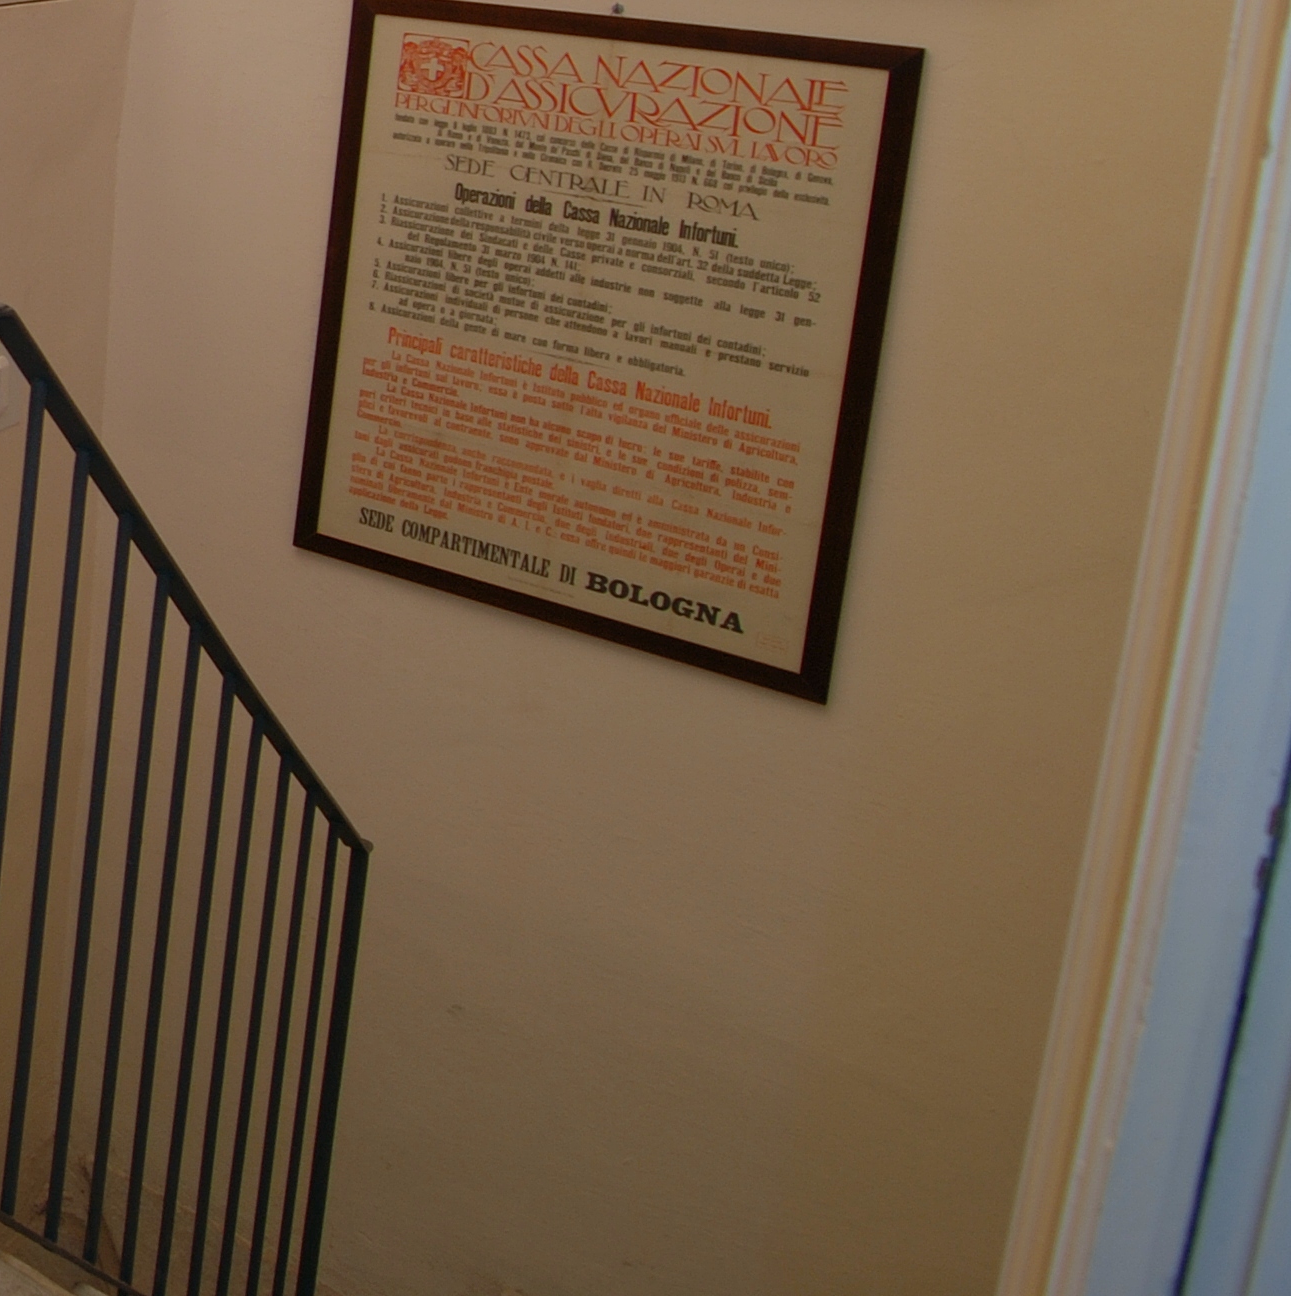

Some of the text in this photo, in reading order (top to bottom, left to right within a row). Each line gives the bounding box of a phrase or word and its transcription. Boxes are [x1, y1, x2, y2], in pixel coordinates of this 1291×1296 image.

[468, 38, 849, 116] CASSA NAZIONALE
[394, 92, 428, 113] PER
[554, 114, 618, 139] DEGLI
[619, 122, 702, 151] OPERAI
[444, 153, 761, 220] SEDE CENTRALE IN ROMA
[454, 181, 740, 248] Operazioni della Cassa Nazionale Infortuni.
[387, 326, 774, 429] Principali caratteristiche della Cassa Nazionale Infortuni.
[358, 506, 395, 535] SEDE
[400, 518, 551, 579] COMPARTIMENTALE
[559, 561, 577, 586] DI
[584, 569, 746, 634] BOLOGNA
